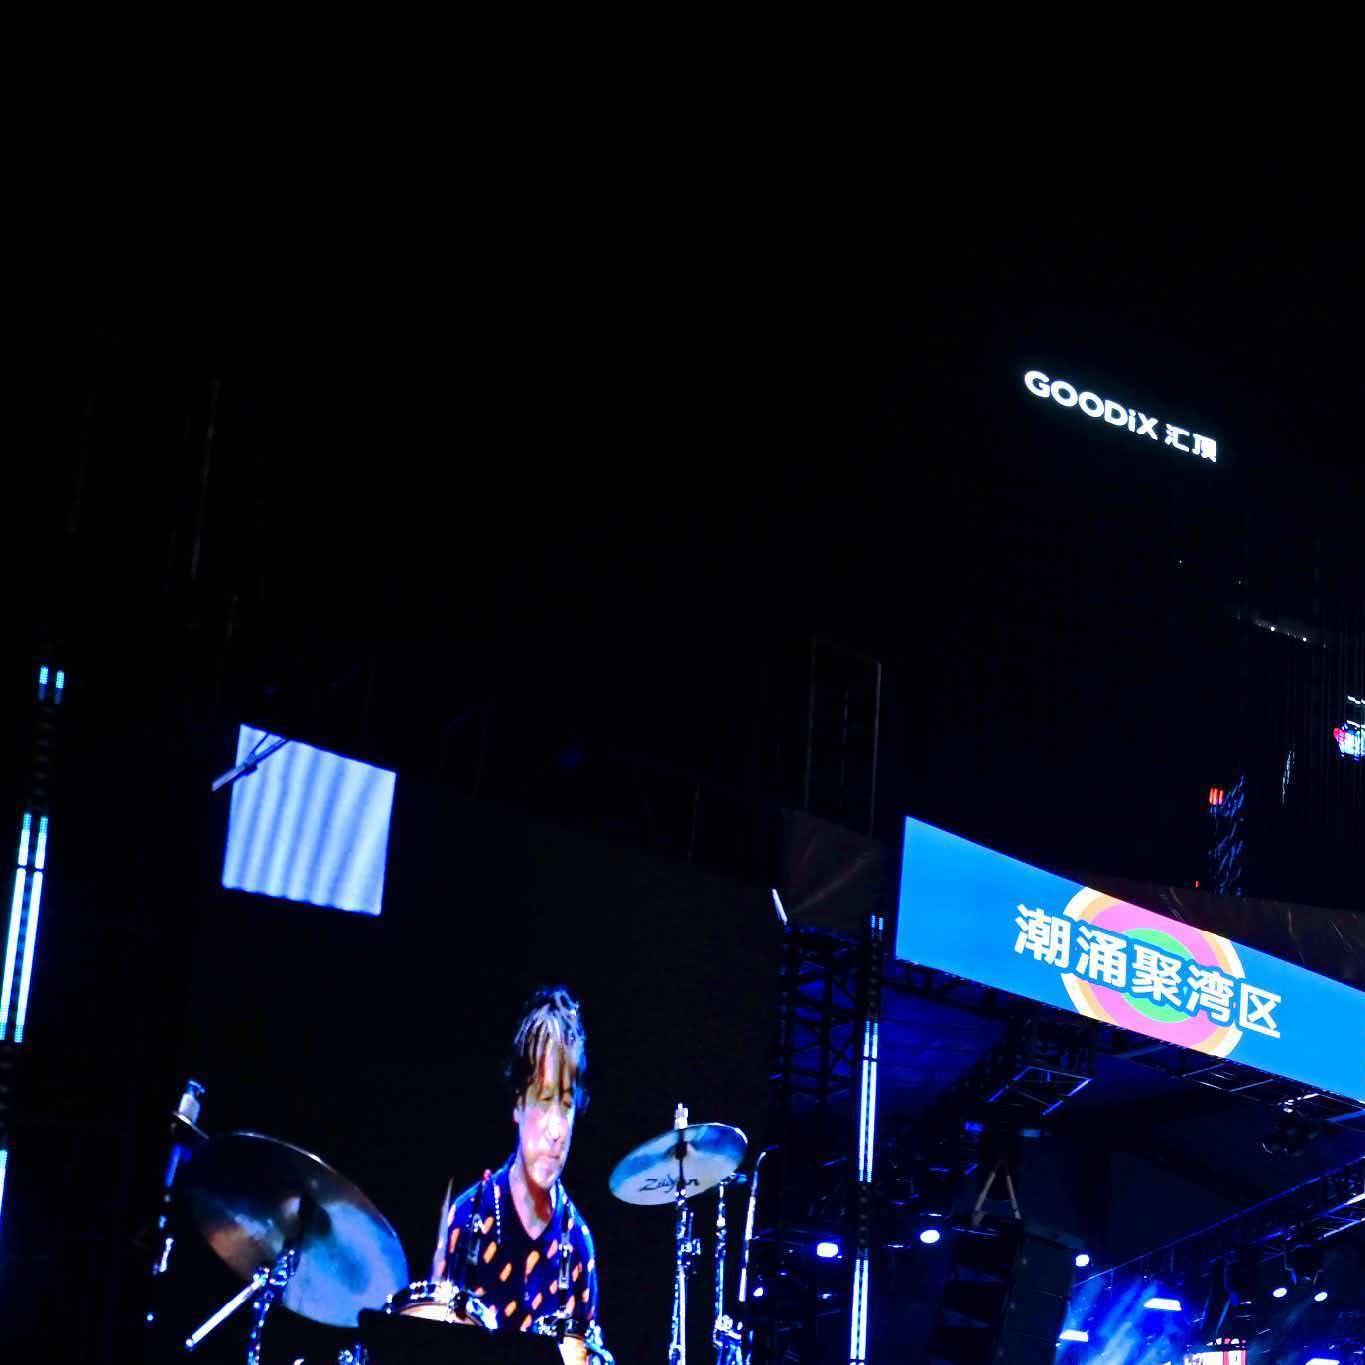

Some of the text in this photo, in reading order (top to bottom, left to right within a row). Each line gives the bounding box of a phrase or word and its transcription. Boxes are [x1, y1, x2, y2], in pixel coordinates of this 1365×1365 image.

[1165, 423, 1217, 463] 汇顶
[1013, 903, 1282, 1040] 潮涌聚湾区
